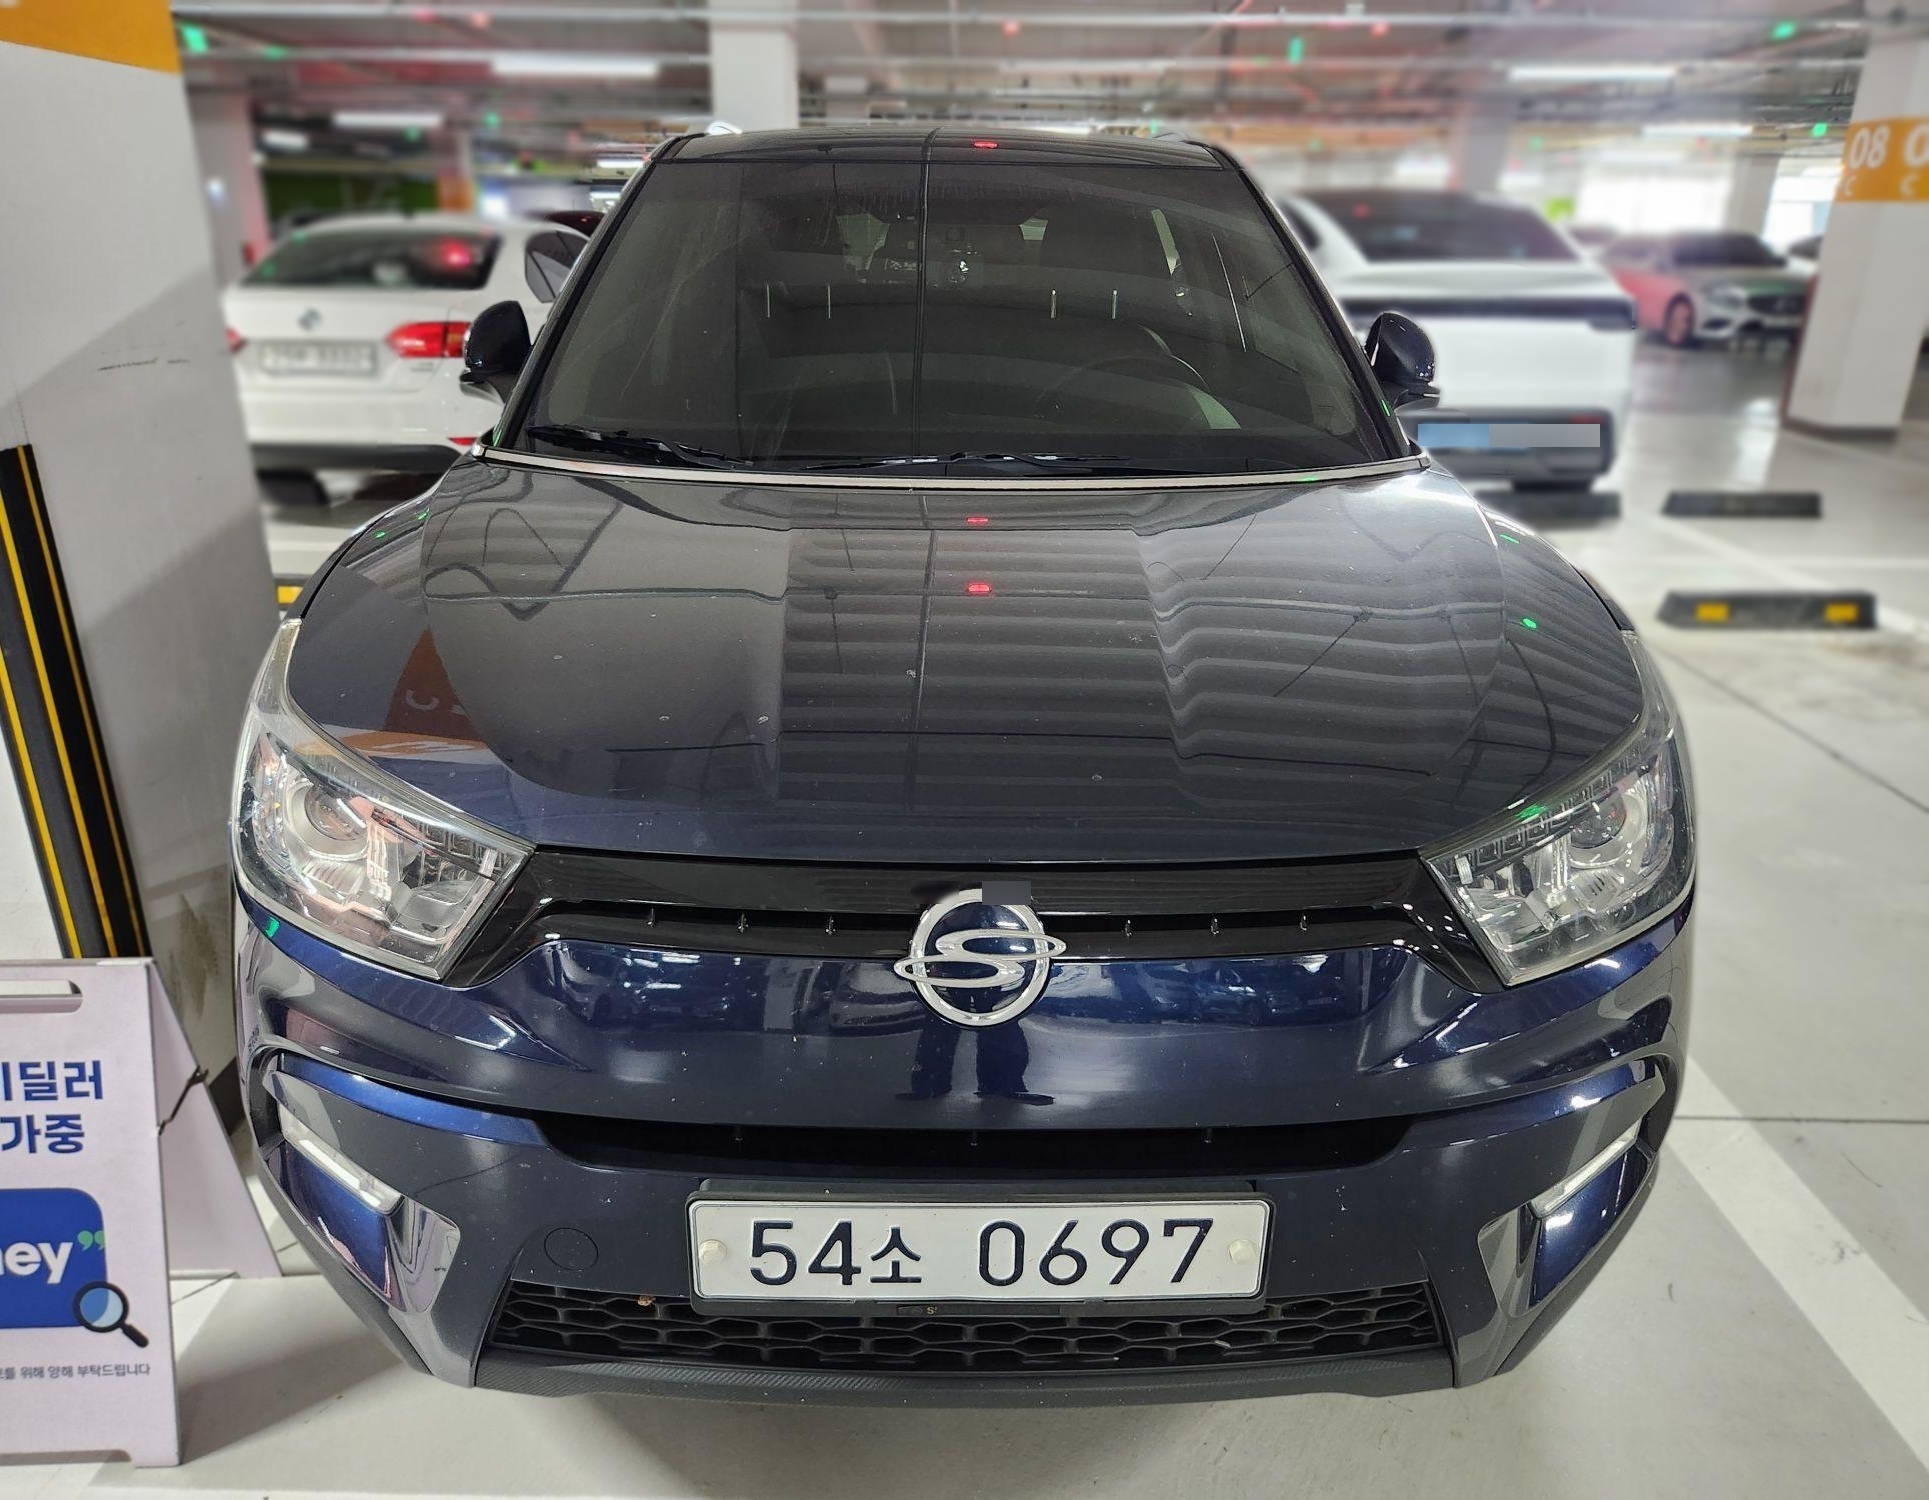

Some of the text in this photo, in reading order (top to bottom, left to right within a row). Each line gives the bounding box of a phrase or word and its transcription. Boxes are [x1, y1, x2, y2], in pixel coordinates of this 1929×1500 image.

[1846, 125, 1890, 170] 08
[0, 1114, 85, 1154] 가중
[749, 1219, 1215, 1286] 54소 0697
[20, 1366, 45, 1379] 위해
[48, 1365, 74, 1379] 양해
[77, 1363, 151, 1378] 부탁드립니다
